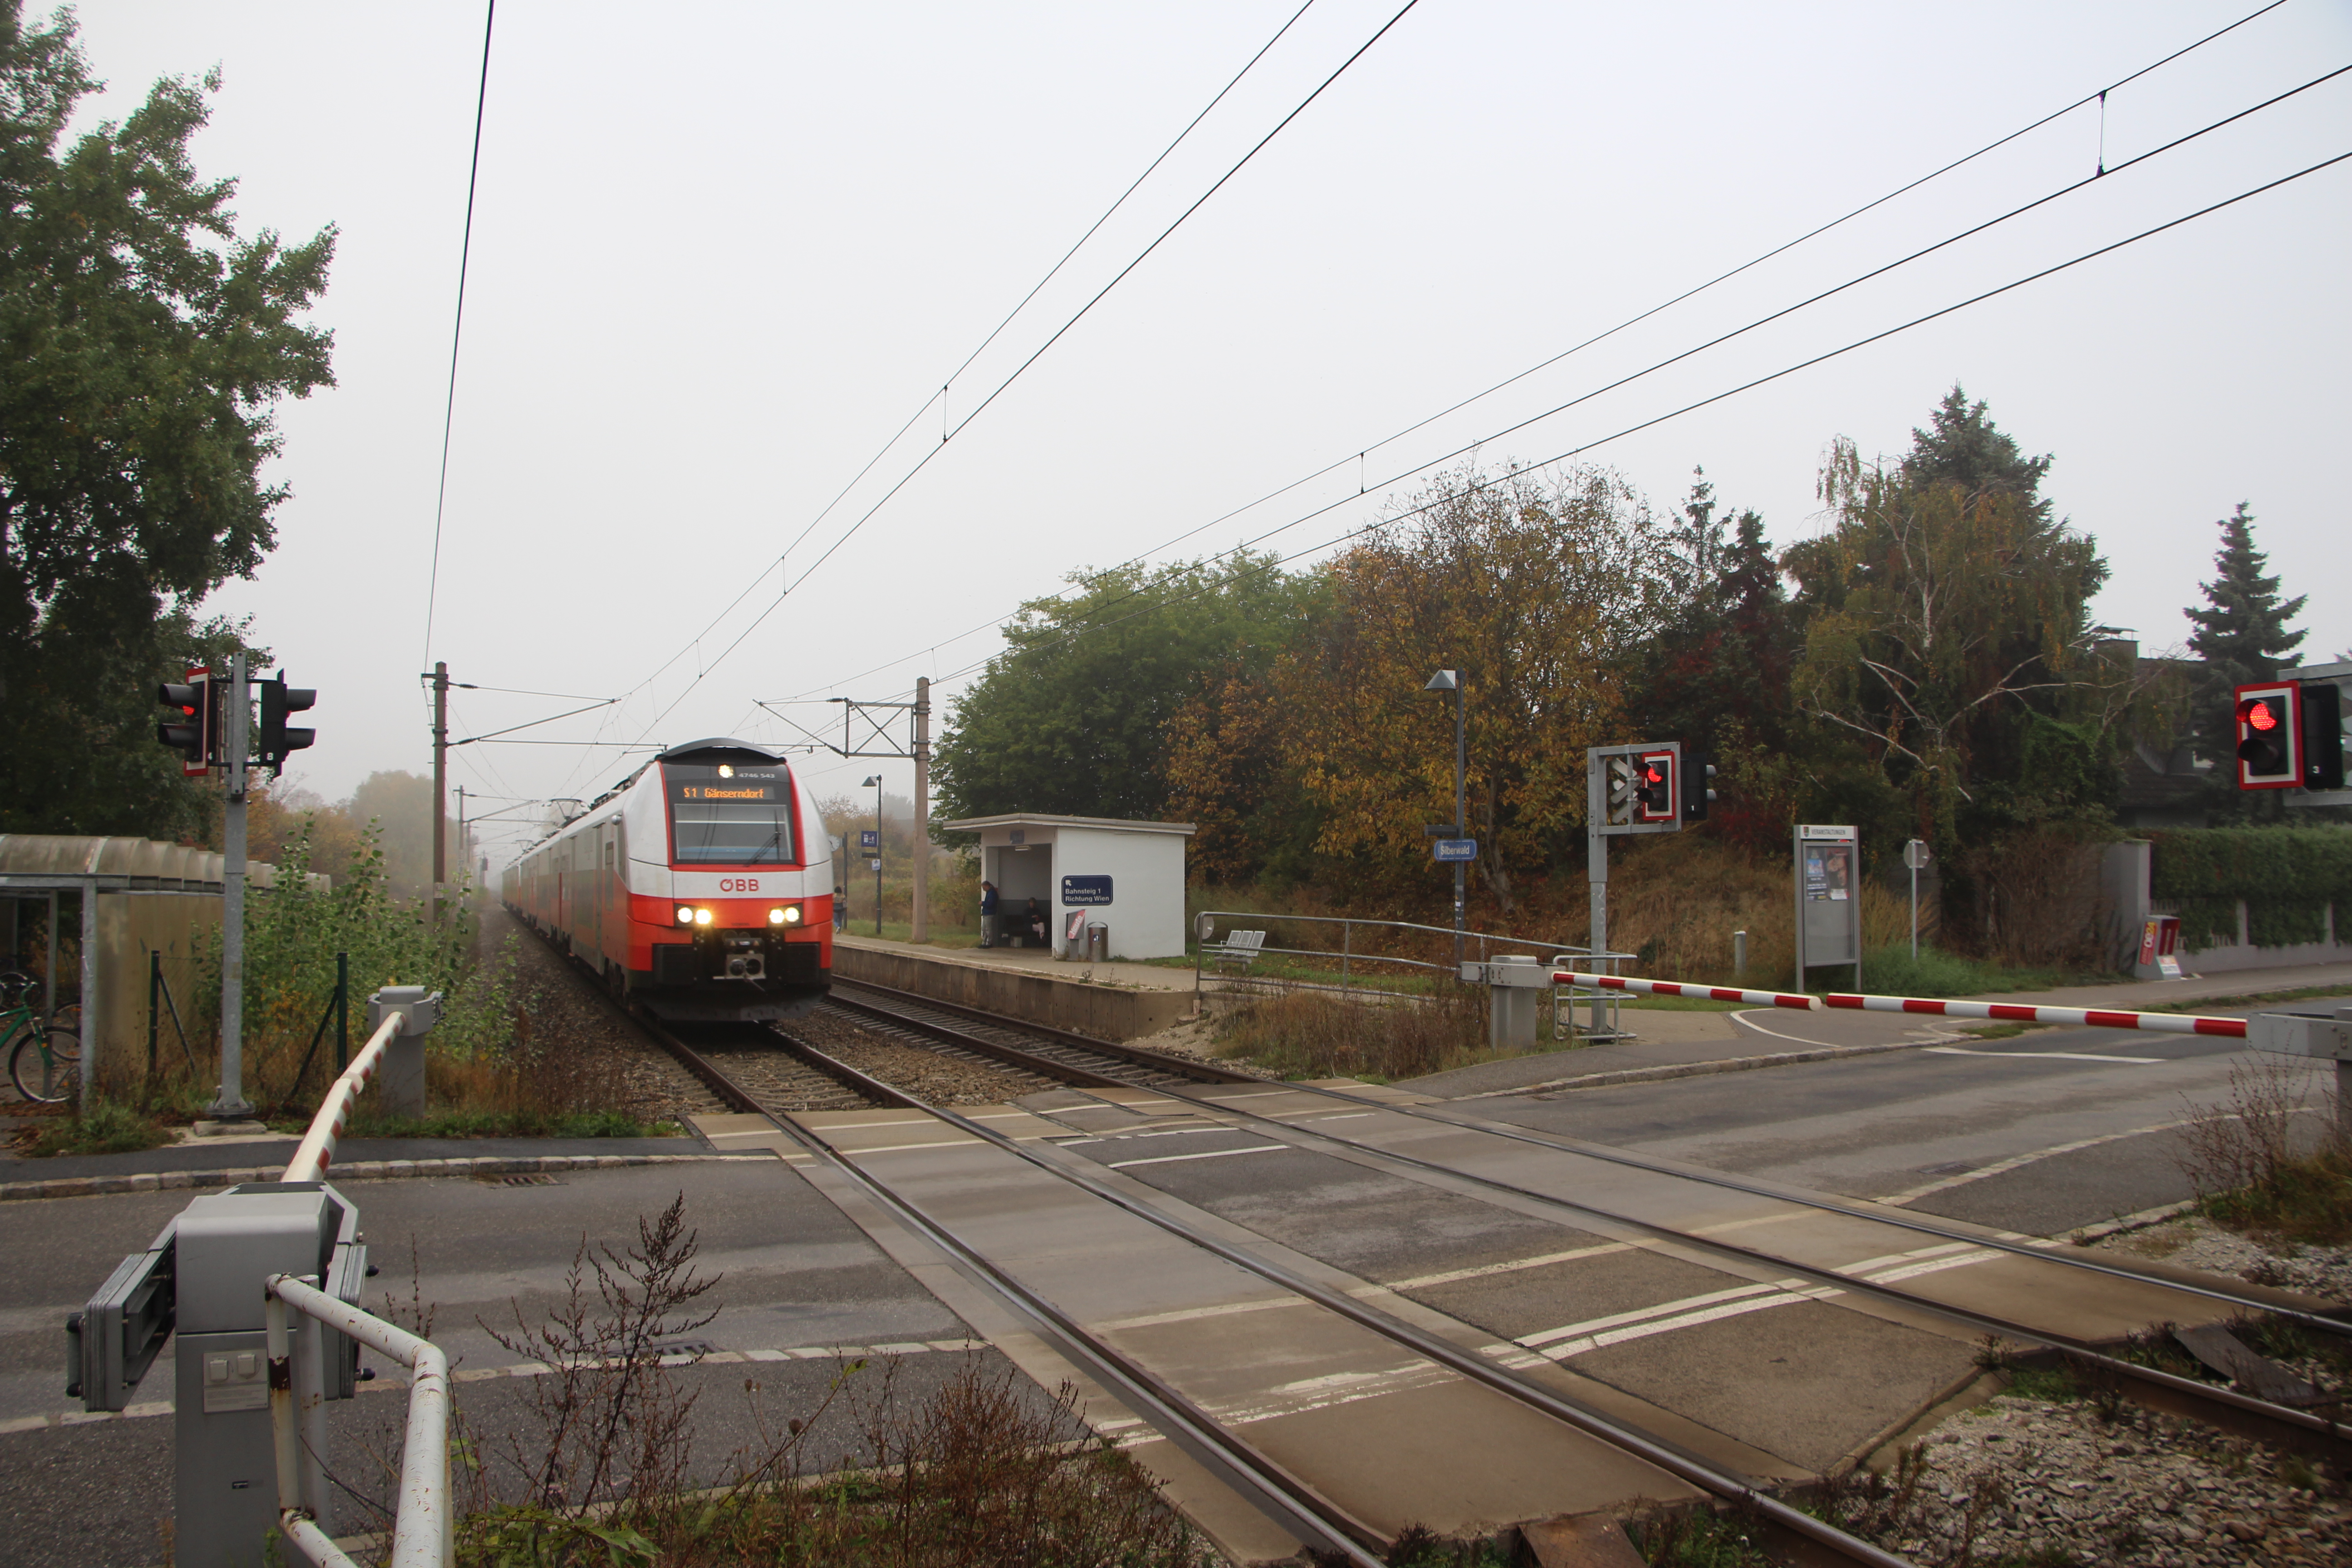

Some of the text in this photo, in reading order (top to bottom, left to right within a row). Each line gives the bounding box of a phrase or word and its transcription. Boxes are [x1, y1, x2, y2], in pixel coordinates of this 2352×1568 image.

[267, 752, 274, 760] 8
[2313, 765, 2320, 774] 3
[705, 788, 764, 798] Gänserndorf
[1441, 845, 1470, 855] Silberwald
[720, 878, 759, 892] ÖBB
[1069, 915, 1083, 935] Heute
